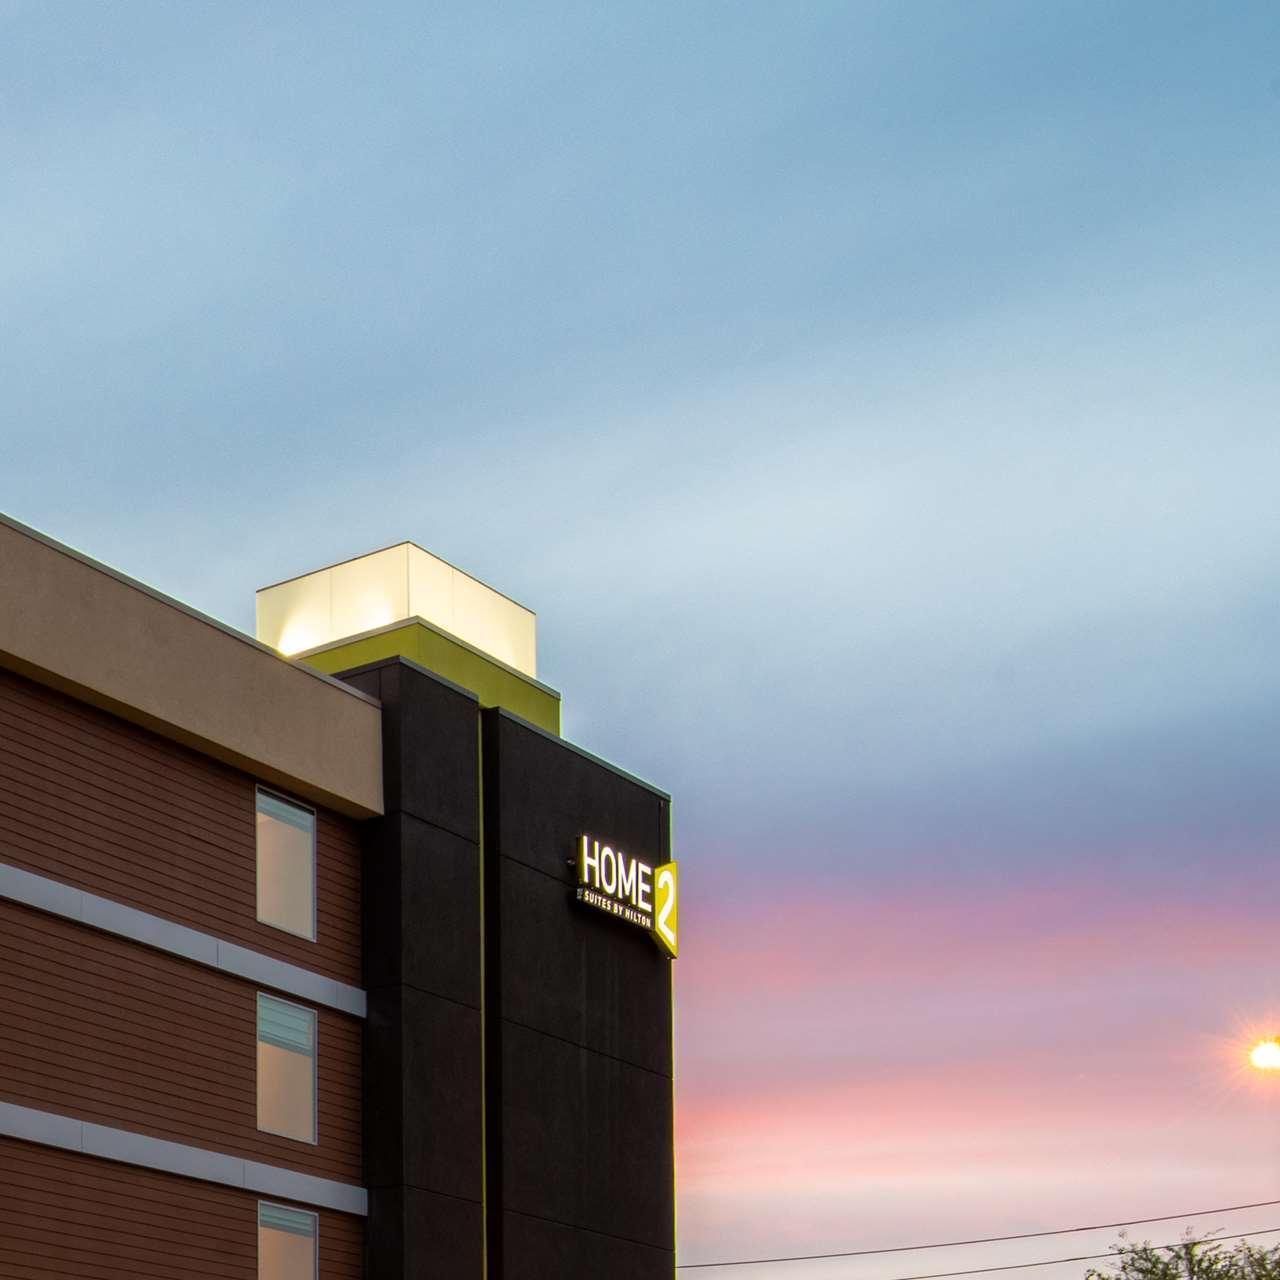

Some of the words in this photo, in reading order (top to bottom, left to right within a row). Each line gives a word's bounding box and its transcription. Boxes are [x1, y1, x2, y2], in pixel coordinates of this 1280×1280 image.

[584, 889, 611, 911] SUITES
[612, 902, 624, 916] BY
[624, 907, 651, 928] HILTON
